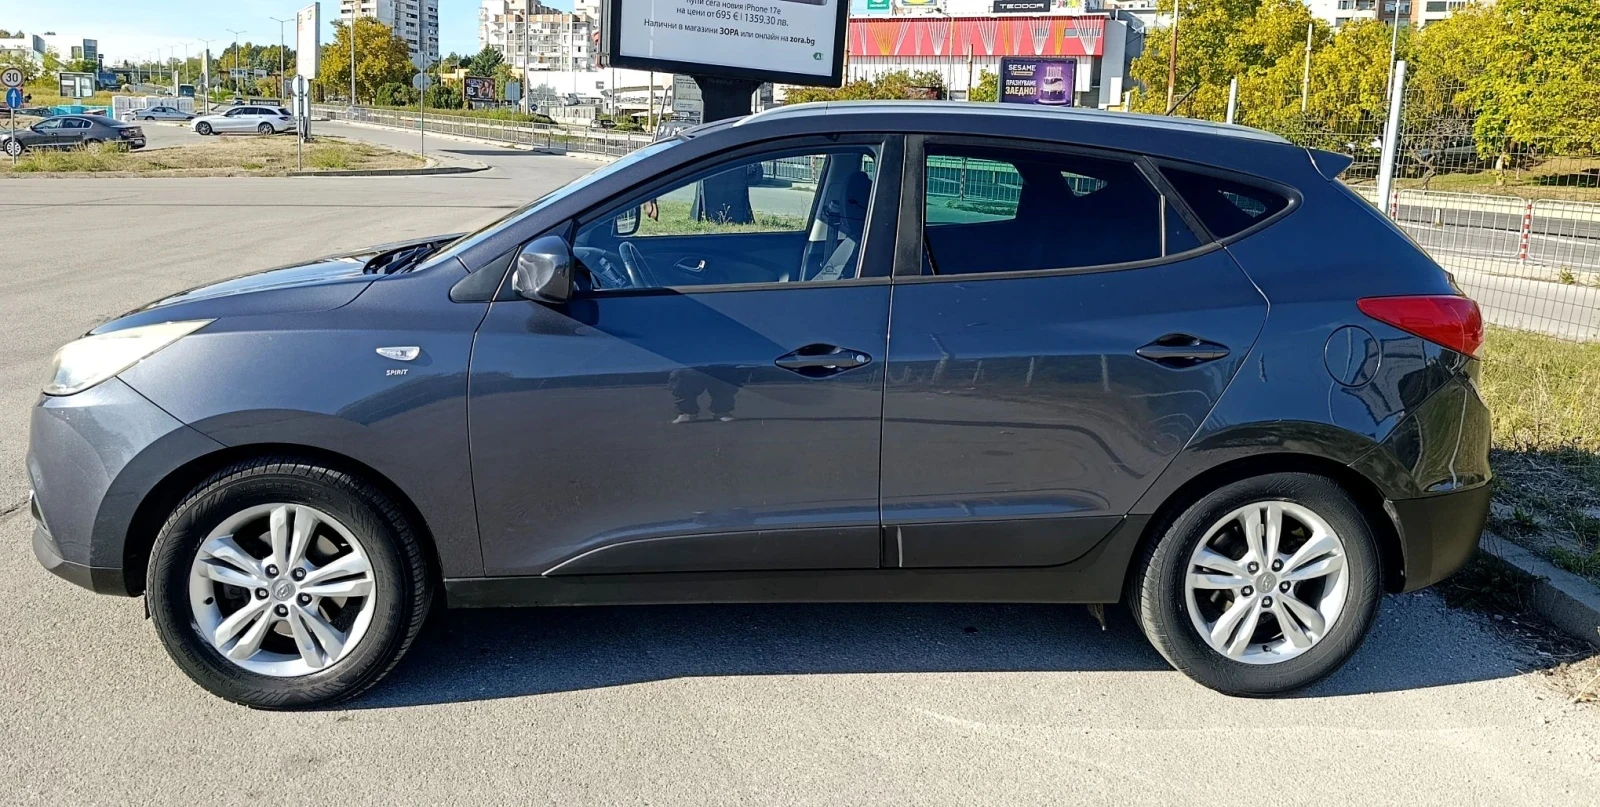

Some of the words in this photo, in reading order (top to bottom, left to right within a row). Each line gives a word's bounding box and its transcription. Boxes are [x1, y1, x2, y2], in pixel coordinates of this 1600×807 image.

[744, 4, 768, 13] iPhone
[687, 8, 706, 16] цени
[715, 10, 731, 20] 695
[732, 12, 739, 20] €
[745, 13, 776, 25] 1359.30
[776, 19, 789, 27] лв.
[643, 18, 677, 29] Налични
[684, 25, 718, 34] магазини
[719, 27, 739, 36] ЗОРА
[754, 33, 780, 41] онлайн
[789, 37, 816, 46] zora.bg
[5, 72, 19, 82] 30
[1005, 86, 1037, 96] ЗАЕДНО!
[385, 368, 409, 376] SPIRIT
